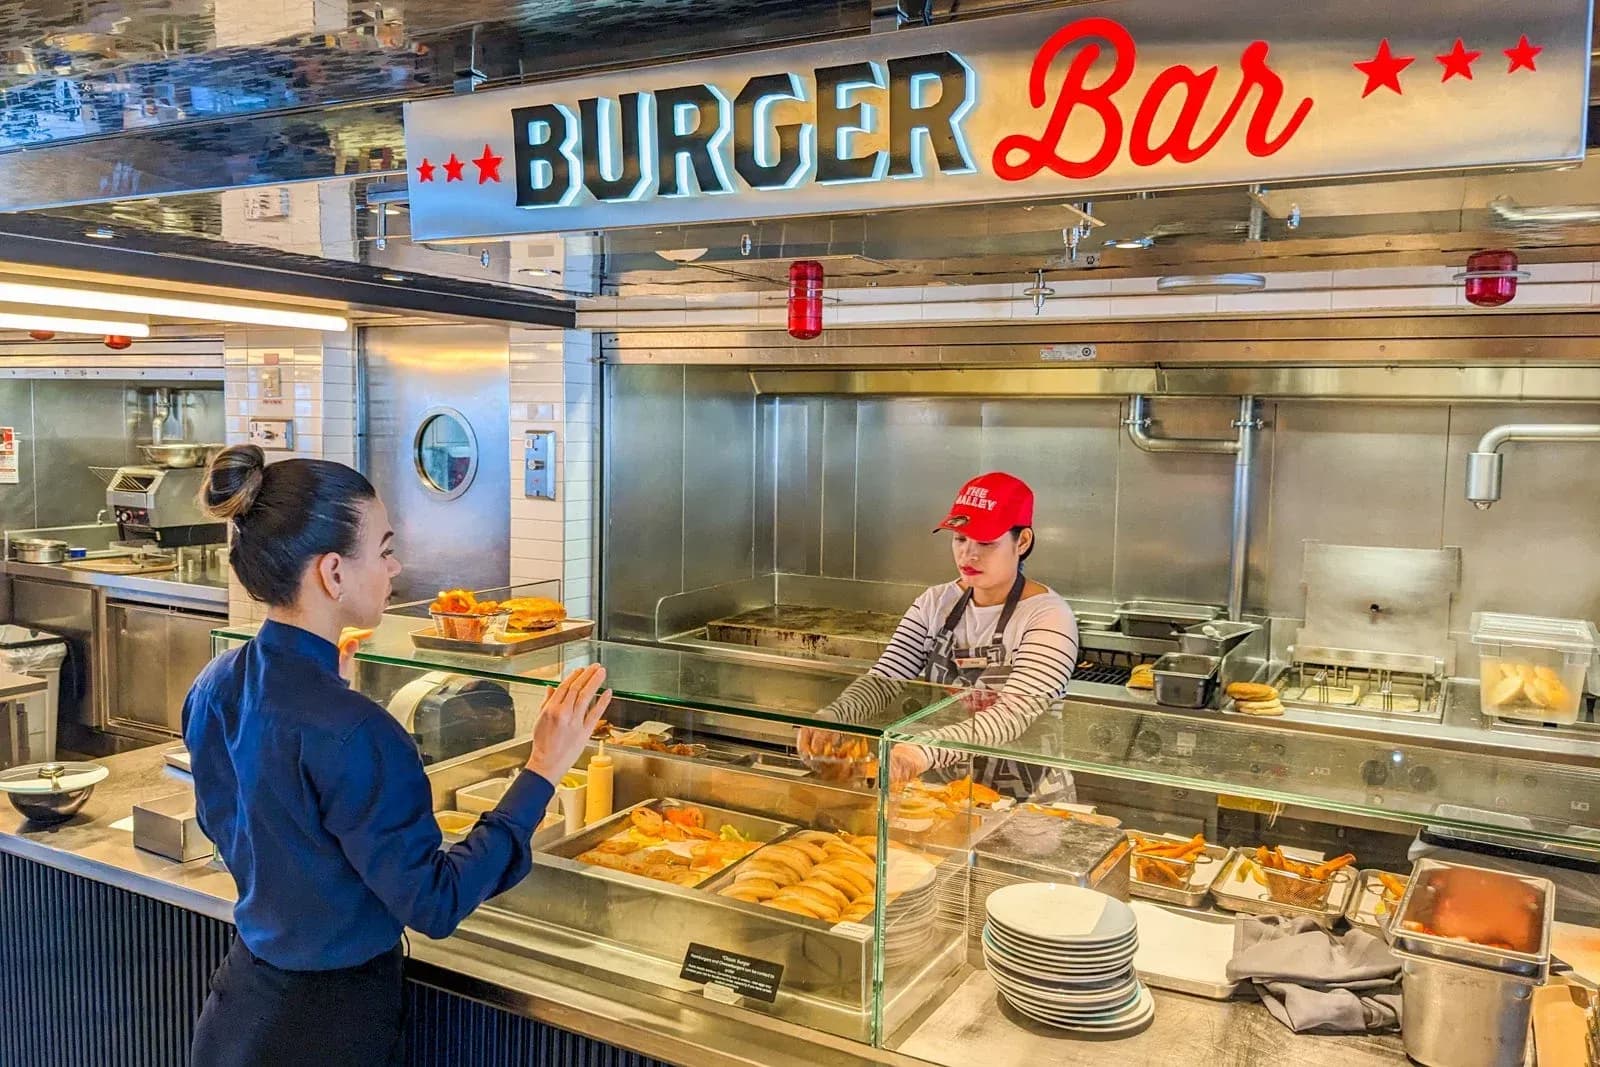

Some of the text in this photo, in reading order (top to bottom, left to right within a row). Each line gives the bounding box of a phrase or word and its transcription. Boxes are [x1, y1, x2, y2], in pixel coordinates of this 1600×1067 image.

[511, 17, 1314, 209] BURGER Bar
[966, 486, 989, 499] THE
